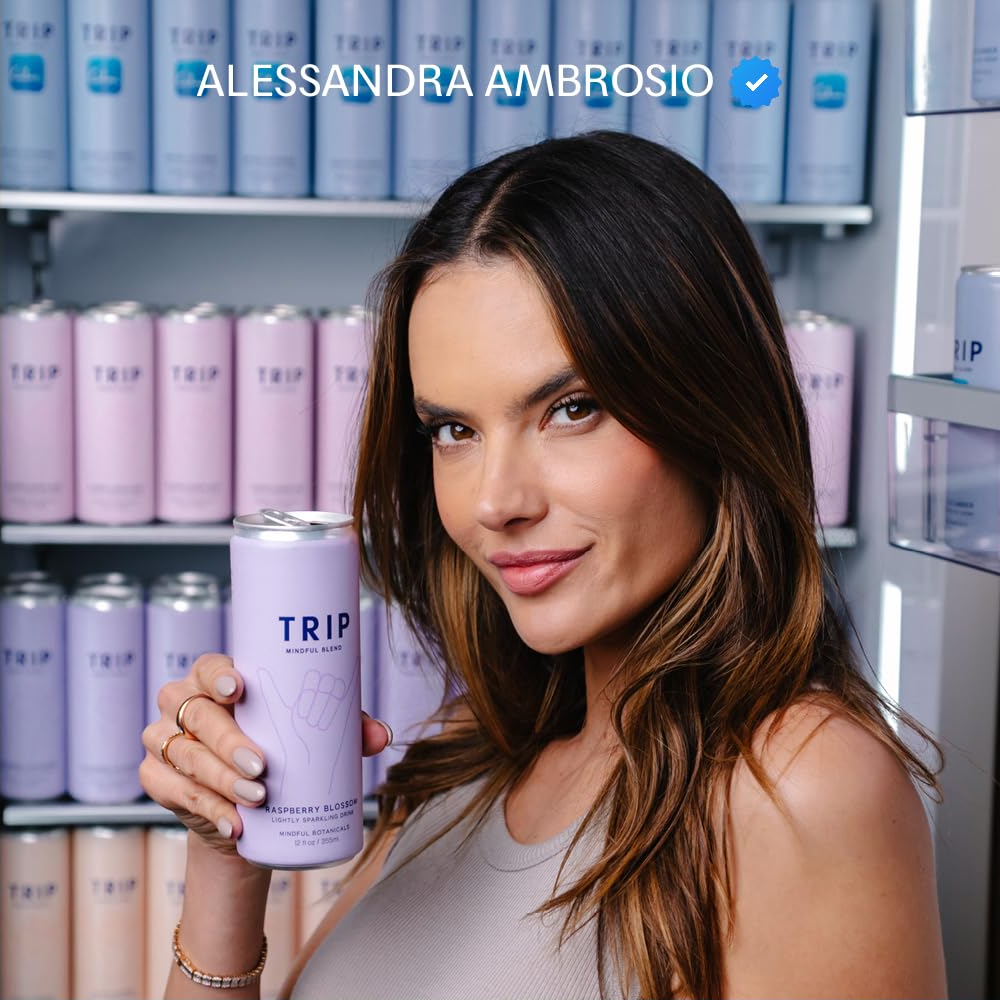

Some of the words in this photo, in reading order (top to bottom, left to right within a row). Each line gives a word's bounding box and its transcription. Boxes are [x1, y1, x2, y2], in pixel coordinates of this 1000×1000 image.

[953, 340, 983, 362] RIP
[279, 612, 350, 641] TRIP
[321, 645, 343, 653] BLEND
[265, 805, 320, 815] RASPBERRY
[302, 813, 338, 824] SPARKLING
[312, 824, 351, 836] BOTANICALS
